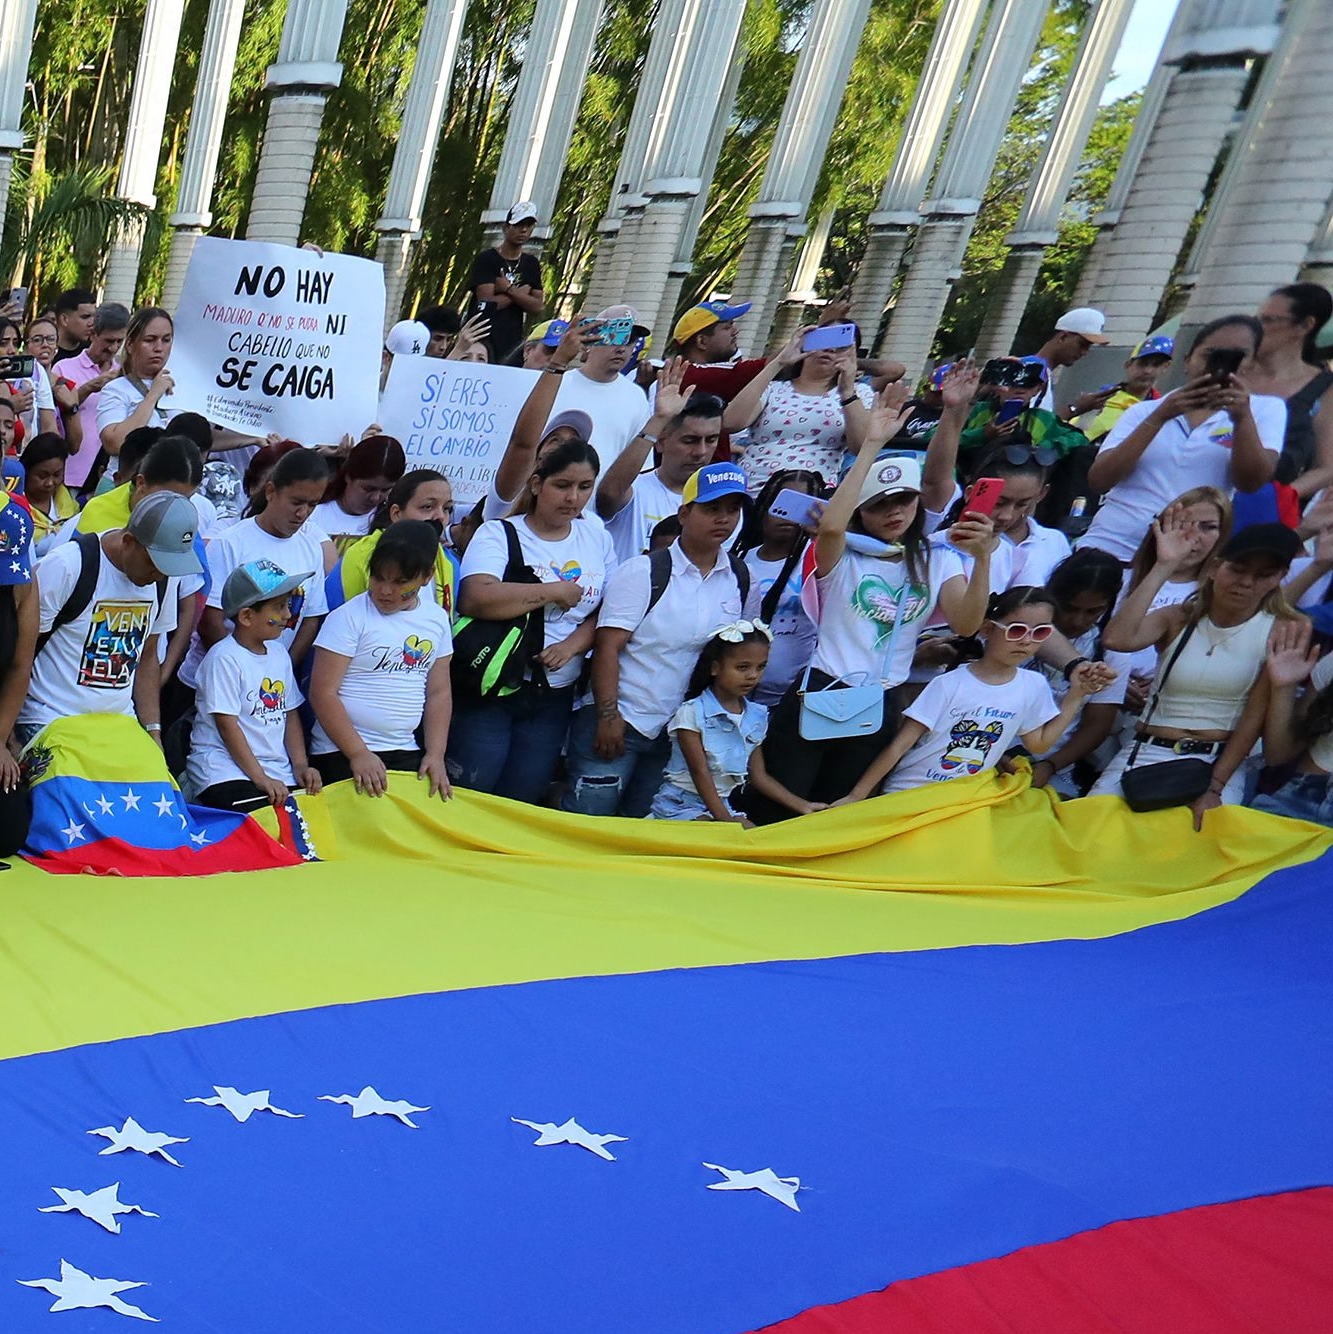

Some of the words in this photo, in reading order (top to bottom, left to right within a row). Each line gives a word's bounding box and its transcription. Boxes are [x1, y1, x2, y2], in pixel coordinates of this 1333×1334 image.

[234, 265, 286, 298] NO
[295, 269, 334, 304] HAY
[202, 303, 253, 326] MADURO
[325, 314, 348, 336] NI
[228, 331, 293, 359] CABELLO
[295, 343, 314, 360] QUE
[316, 345, 331, 359] NO
[215, 357, 258, 391] SE
[262, 363, 334, 400] CAIGA
[405, 434, 424, 456] EL
[105, 611, 144, 633] VEN
[95, 636, 136, 656] EZU
[91, 658, 131, 681] ELA
[949, 707, 968, 720] Soy
[971, 705, 982, 718] el
